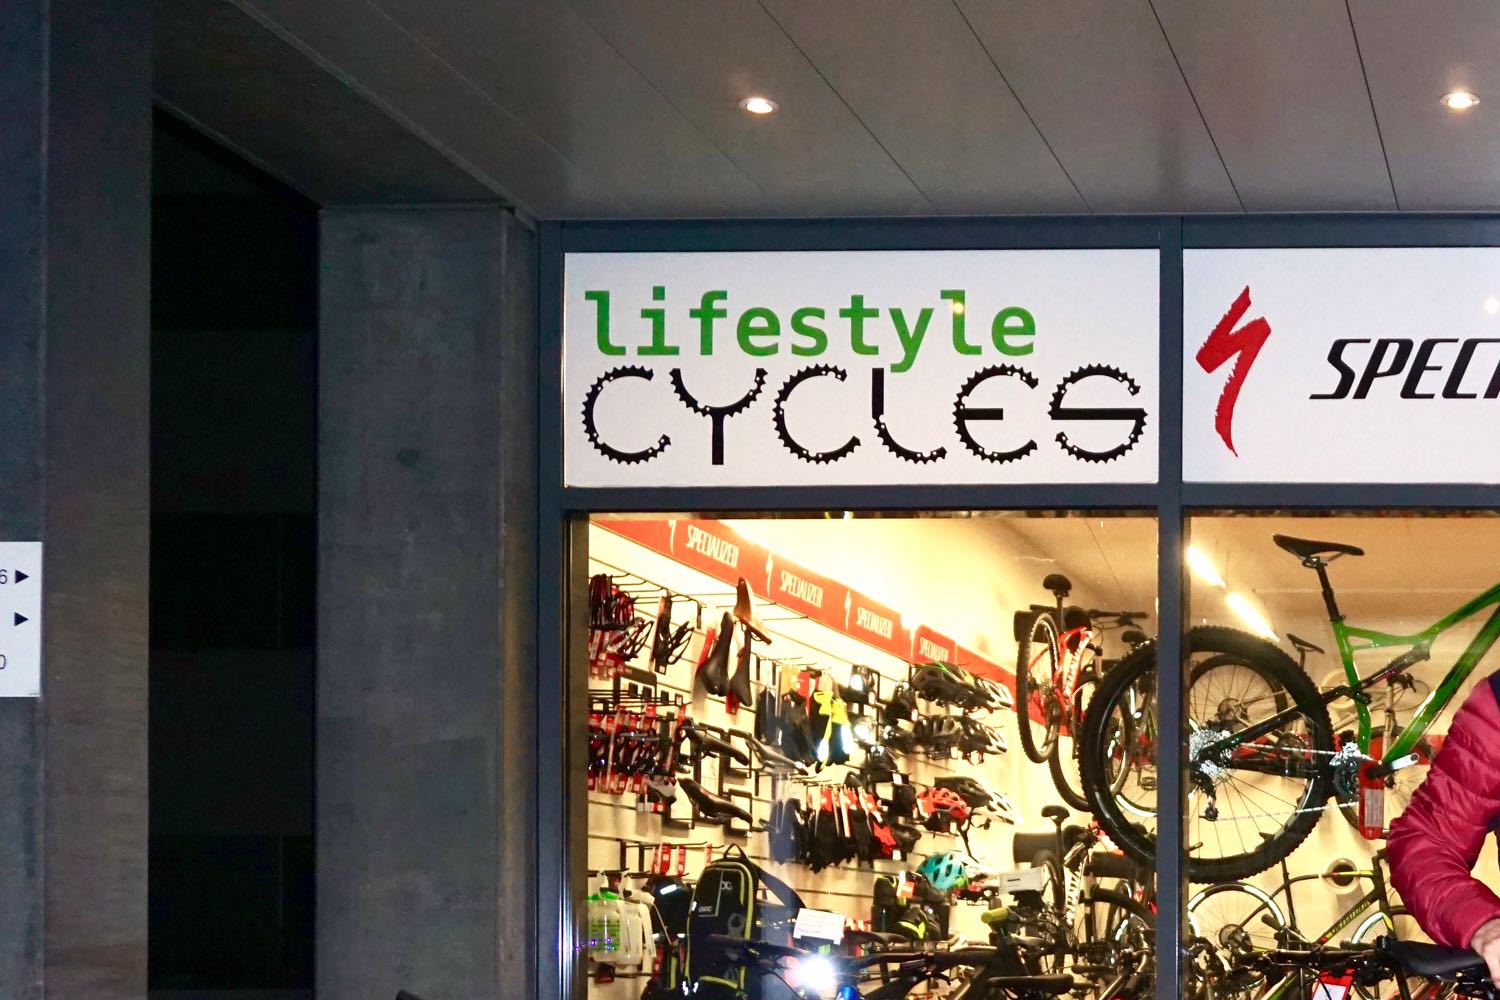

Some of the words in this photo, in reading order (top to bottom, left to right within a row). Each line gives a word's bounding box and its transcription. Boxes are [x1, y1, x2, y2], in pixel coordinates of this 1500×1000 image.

[585, 286, 1036, 373] lifestyle
[581, 363, 1148, 466] CYCLES
[686, 524, 740, 569] SPECIALIZED
